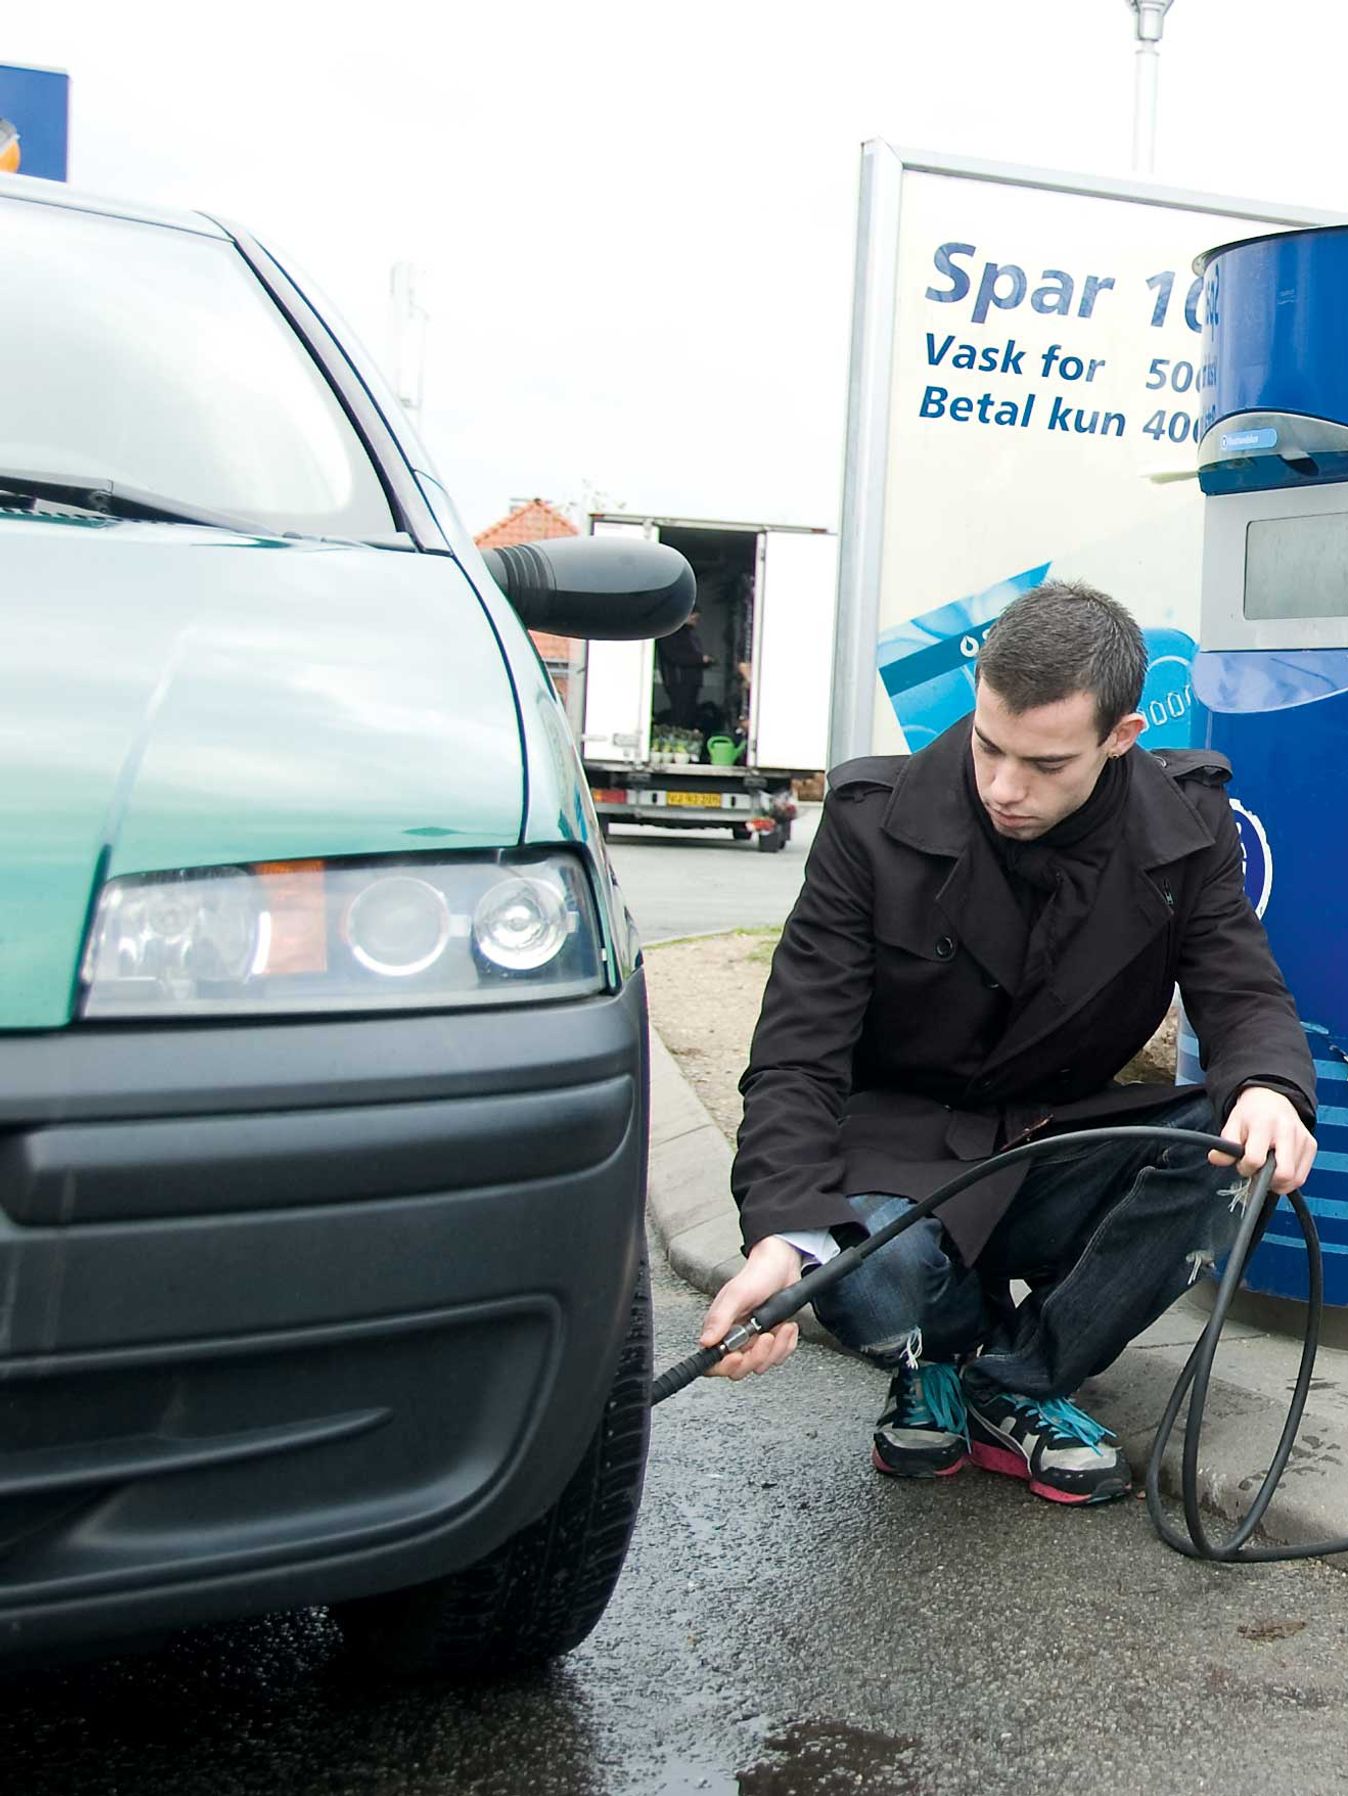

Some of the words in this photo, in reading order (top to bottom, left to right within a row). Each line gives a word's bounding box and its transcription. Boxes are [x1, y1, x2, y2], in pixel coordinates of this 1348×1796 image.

[924, 241, 1116, 324] Spar
[925, 332, 1028, 375] Vask
[1041, 343, 1107, 383] for
[1145, 358, 1203, 394] 50
[918, 384, 1036, 428] Betal
[1047, 396, 1126, 437] kun
[1141, 409, 1200, 445] 40
